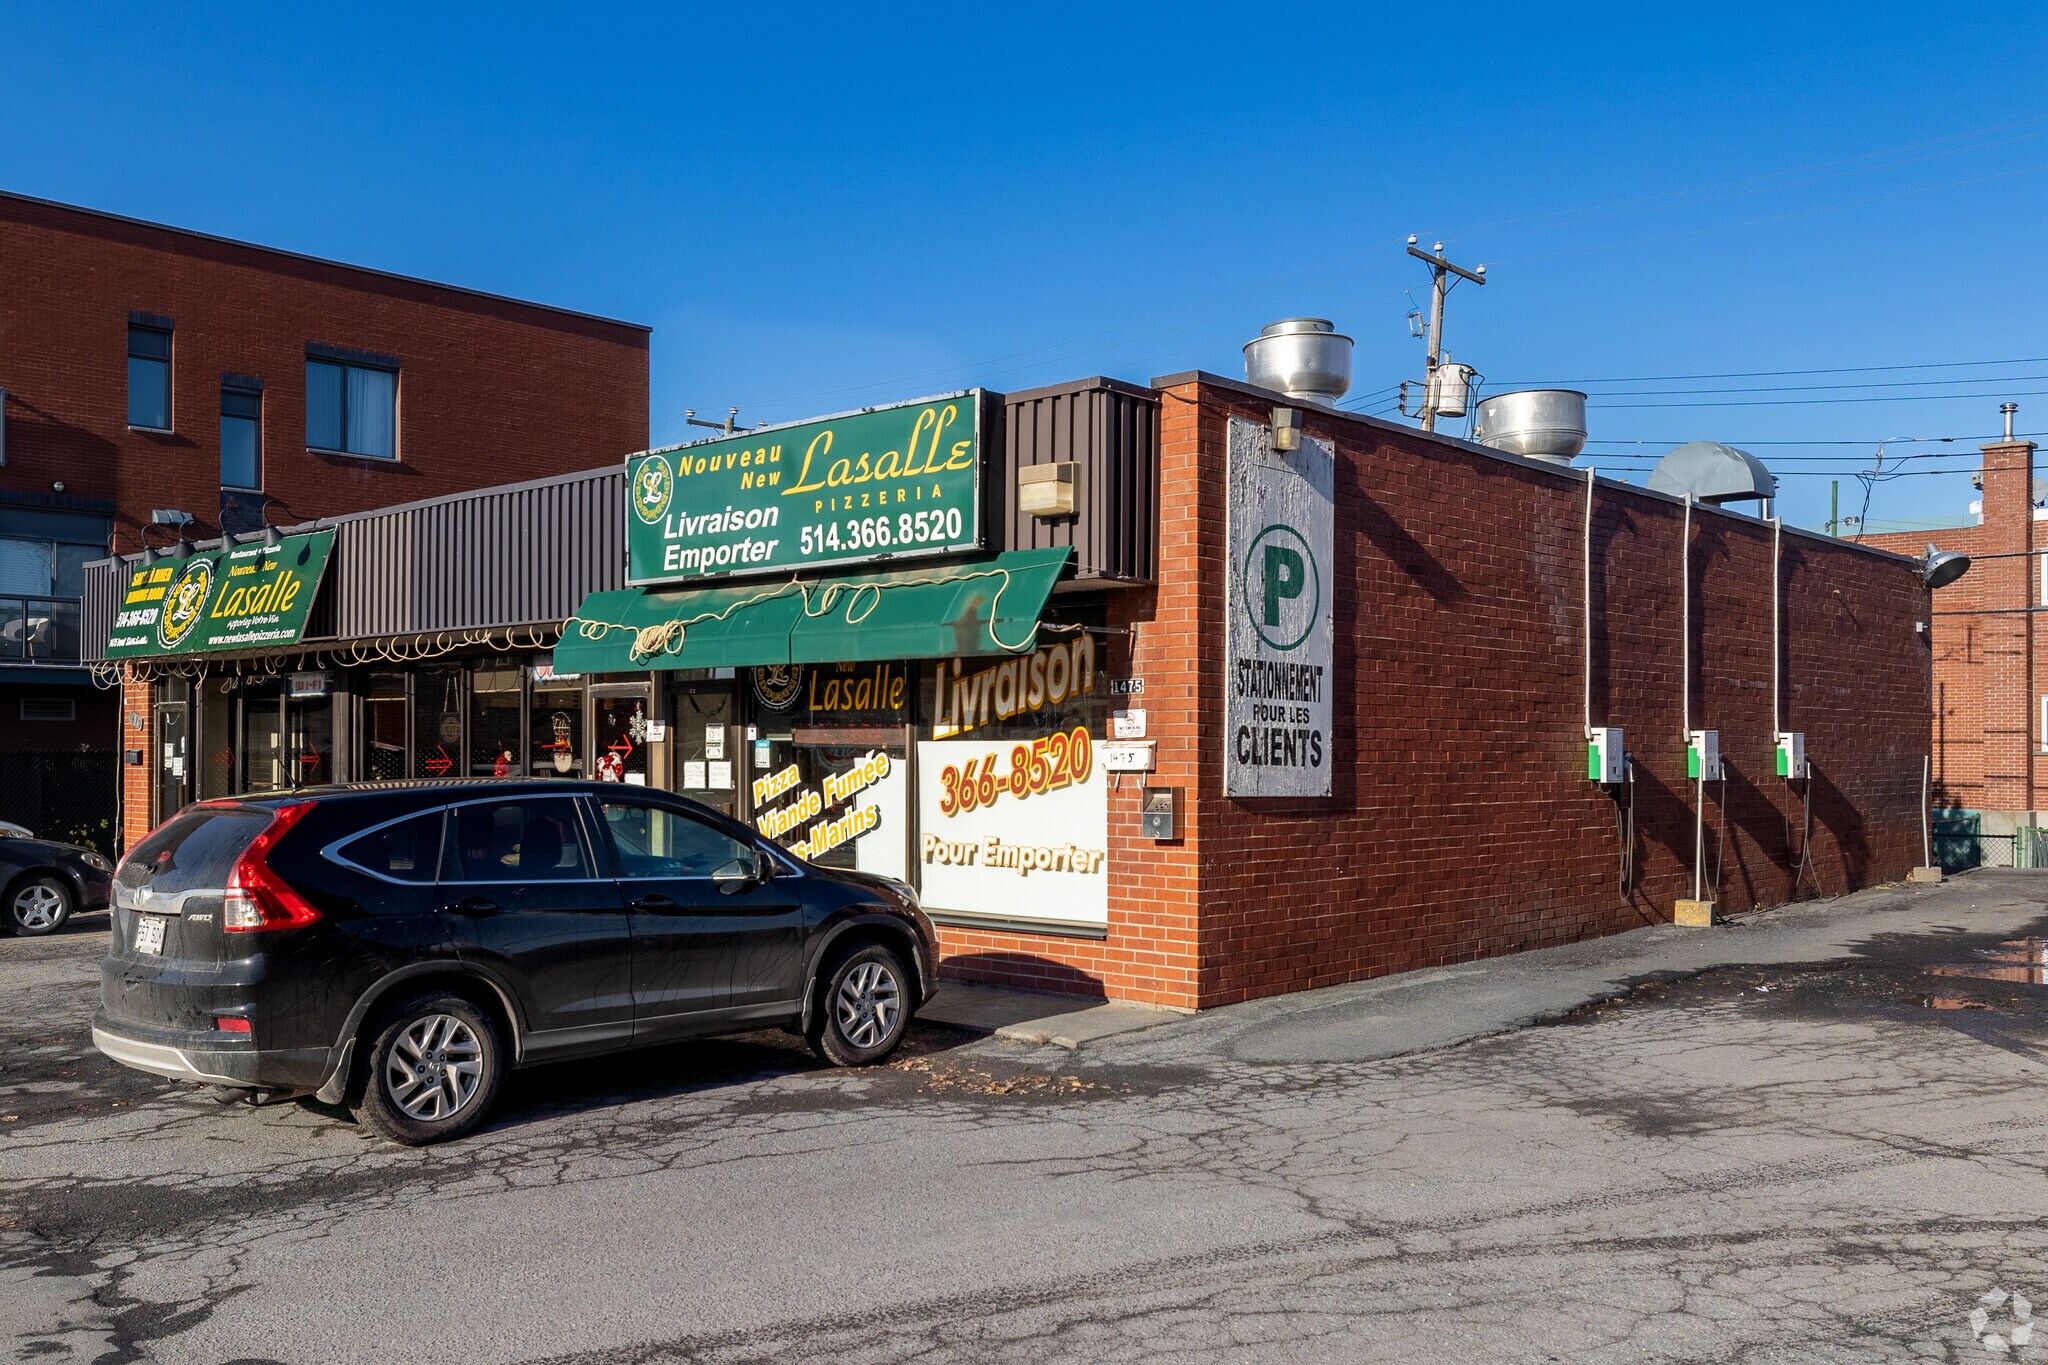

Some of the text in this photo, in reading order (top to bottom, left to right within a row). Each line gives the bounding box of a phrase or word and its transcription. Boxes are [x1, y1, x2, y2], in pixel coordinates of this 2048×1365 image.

[678, 445, 782, 477] Nouveau
[740, 471, 781, 490] New
[815, 483, 942, 514] PIZZERIA
[663, 505, 780, 539] Livraison
[800, 507, 963, 555] 514.366.8520
[229, 548, 258, 559] Restaurant
[262, 560, 278, 572] New
[663, 536, 780, 574] Emporter
[210, 570, 301, 618] Lasalle
[1264, 544, 1305, 627] P
[116, 608, 159, 628] 514-366-8520
[208, 628, 296, 645] www.newlasallepizzeria.com
[295, 679, 322, 691] WI-FI
[809, 664, 904, 712] Lasalle
[933, 633, 1096, 741] Livraison
[1113, 680, 1142, 693] 1475
[1237, 658, 1323, 703] STATIONNEMENT
[1253, 703, 1310, 724] POUR LES
[1237, 725, 1323, 768] CLIENTS
[753, 763, 802, 809] Pizza
[939, 726, 1092, 817] 366-8520
[756, 749, 890, 839] Viande Fumée
[786, 804, 877, 861] s-Marins
[921, 833, 1105, 876] Pour Emporter
